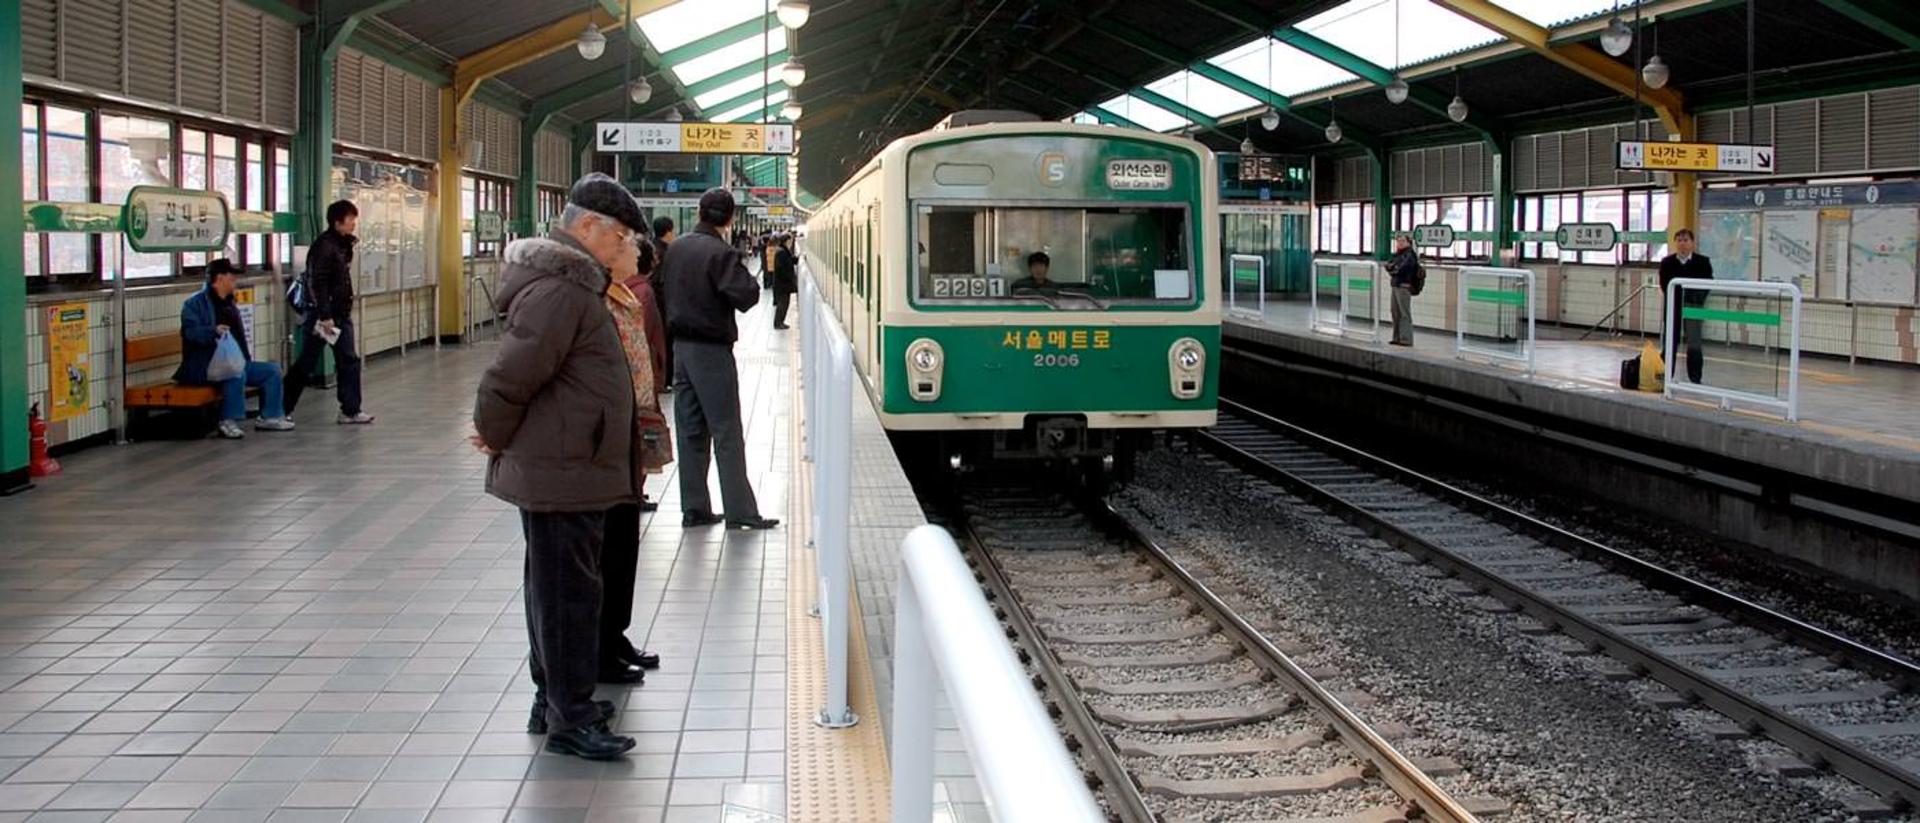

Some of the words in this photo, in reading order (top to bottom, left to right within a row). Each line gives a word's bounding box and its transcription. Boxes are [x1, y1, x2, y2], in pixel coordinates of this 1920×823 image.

[686, 128, 732, 141] 나가는
[745, 128, 759, 141] 곳
[687, 140, 704, 149] Way
[705, 140, 721, 148] Out
[1650, 146, 1687, 159] 나가는
[1696, 148, 1709, 160] 곳
[1111, 163, 1167, 178] 외선순환
[936, 279, 1000, 296] 2291
[1002, 330, 1111, 349] 서울메트로
[1034, 354, 1080, 367] 2006
